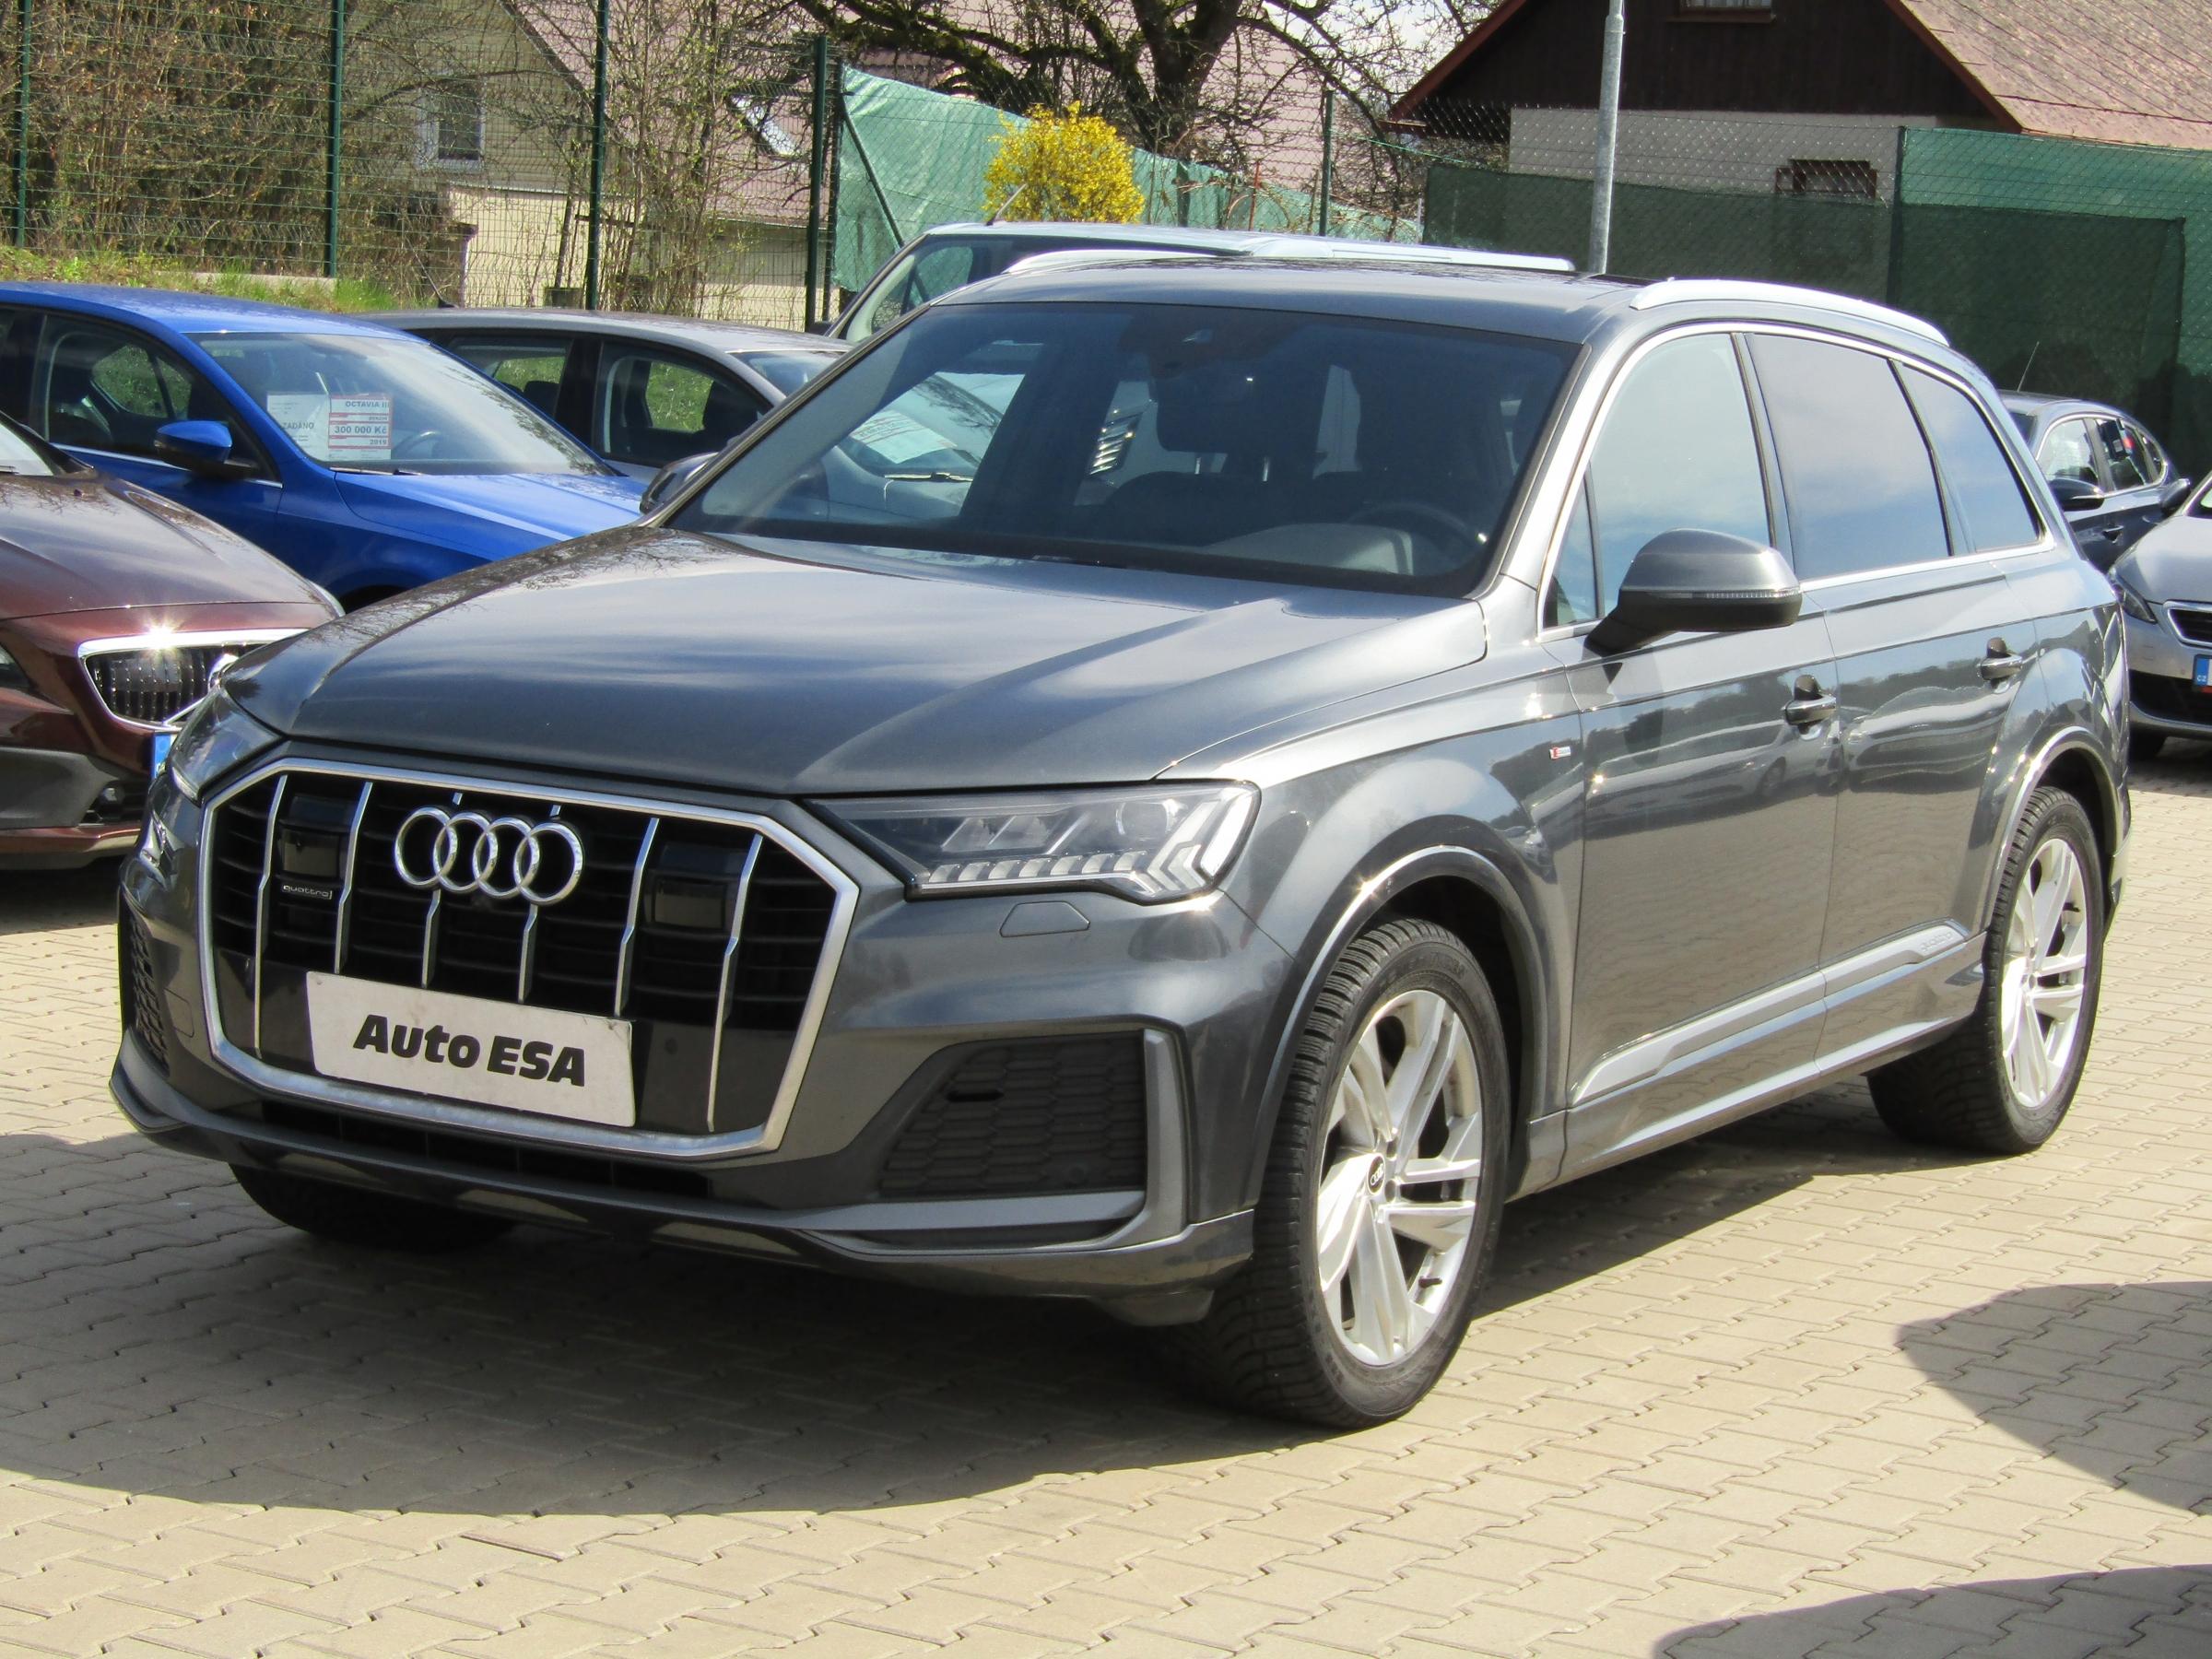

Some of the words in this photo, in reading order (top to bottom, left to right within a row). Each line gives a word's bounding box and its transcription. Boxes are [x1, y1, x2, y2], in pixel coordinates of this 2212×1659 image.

[334, 426, 352, 434] 300
[354, 426, 372, 434] 000
[374, 425, 387, 434] Kč
[282, 885, 332, 900] quattro
[353, 1014, 481, 1069] Auto
[487, 1035, 585, 1088] ESA
